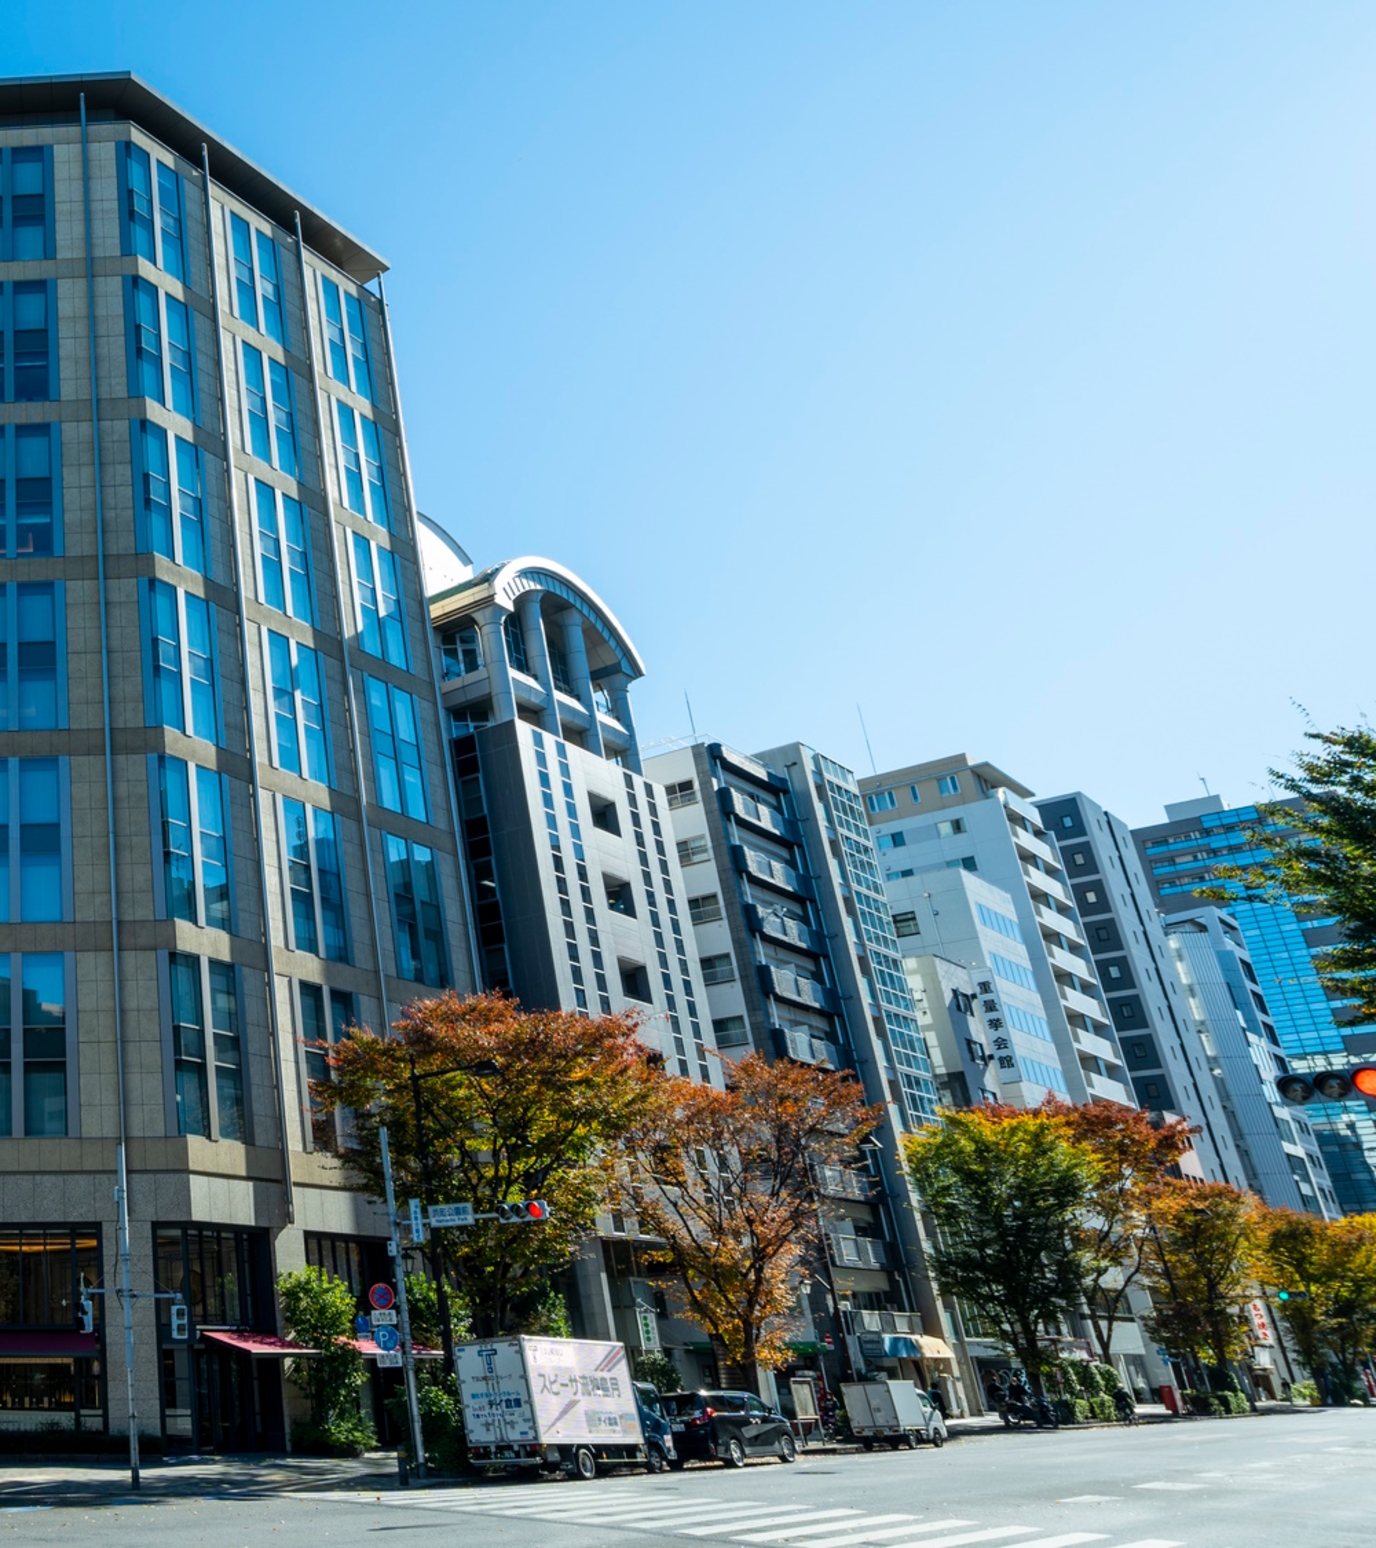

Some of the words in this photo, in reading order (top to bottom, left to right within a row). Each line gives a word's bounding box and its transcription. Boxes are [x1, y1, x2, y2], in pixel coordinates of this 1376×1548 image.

[977, 980, 1015, 1069] 重量挙会館
[432, 1205, 469, 1218] 浜町公園前
[1252, 1303, 1270, 1341] もつ焼き
